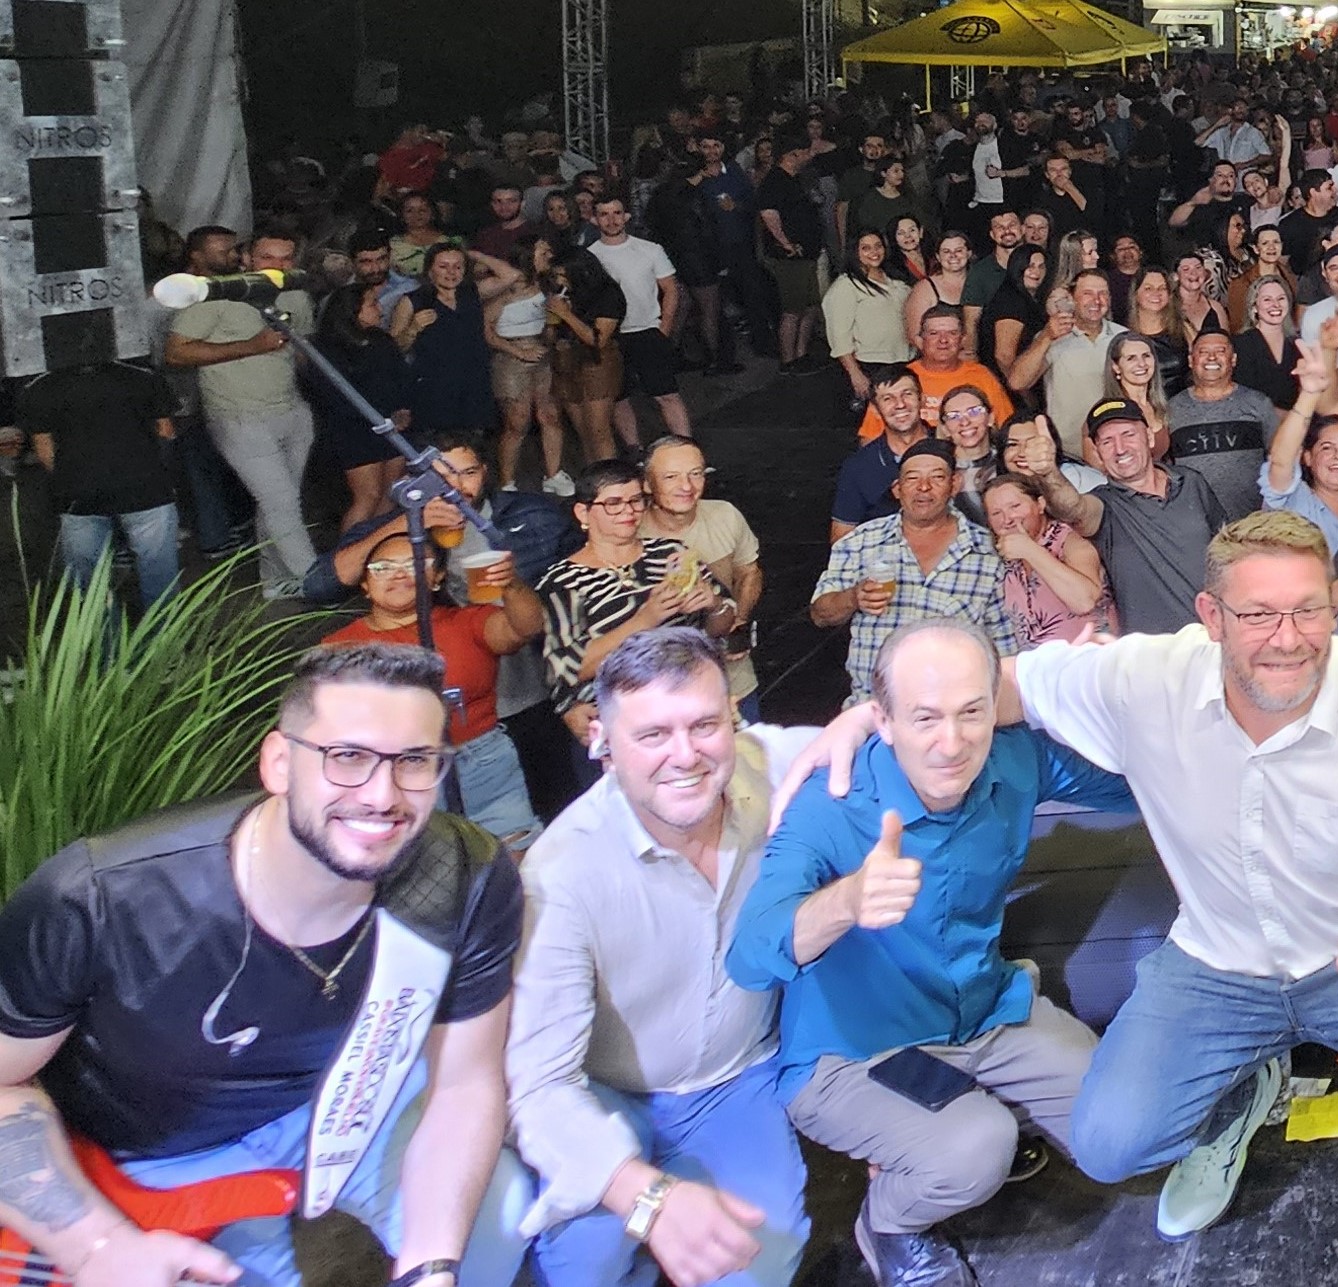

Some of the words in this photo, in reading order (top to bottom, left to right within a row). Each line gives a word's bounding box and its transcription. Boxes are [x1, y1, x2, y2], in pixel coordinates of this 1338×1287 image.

[15, 125, 113, 150] NITROS
[27, 277, 125, 308] NITROS
[347, 1001, 379, 1060] CASSIEL
